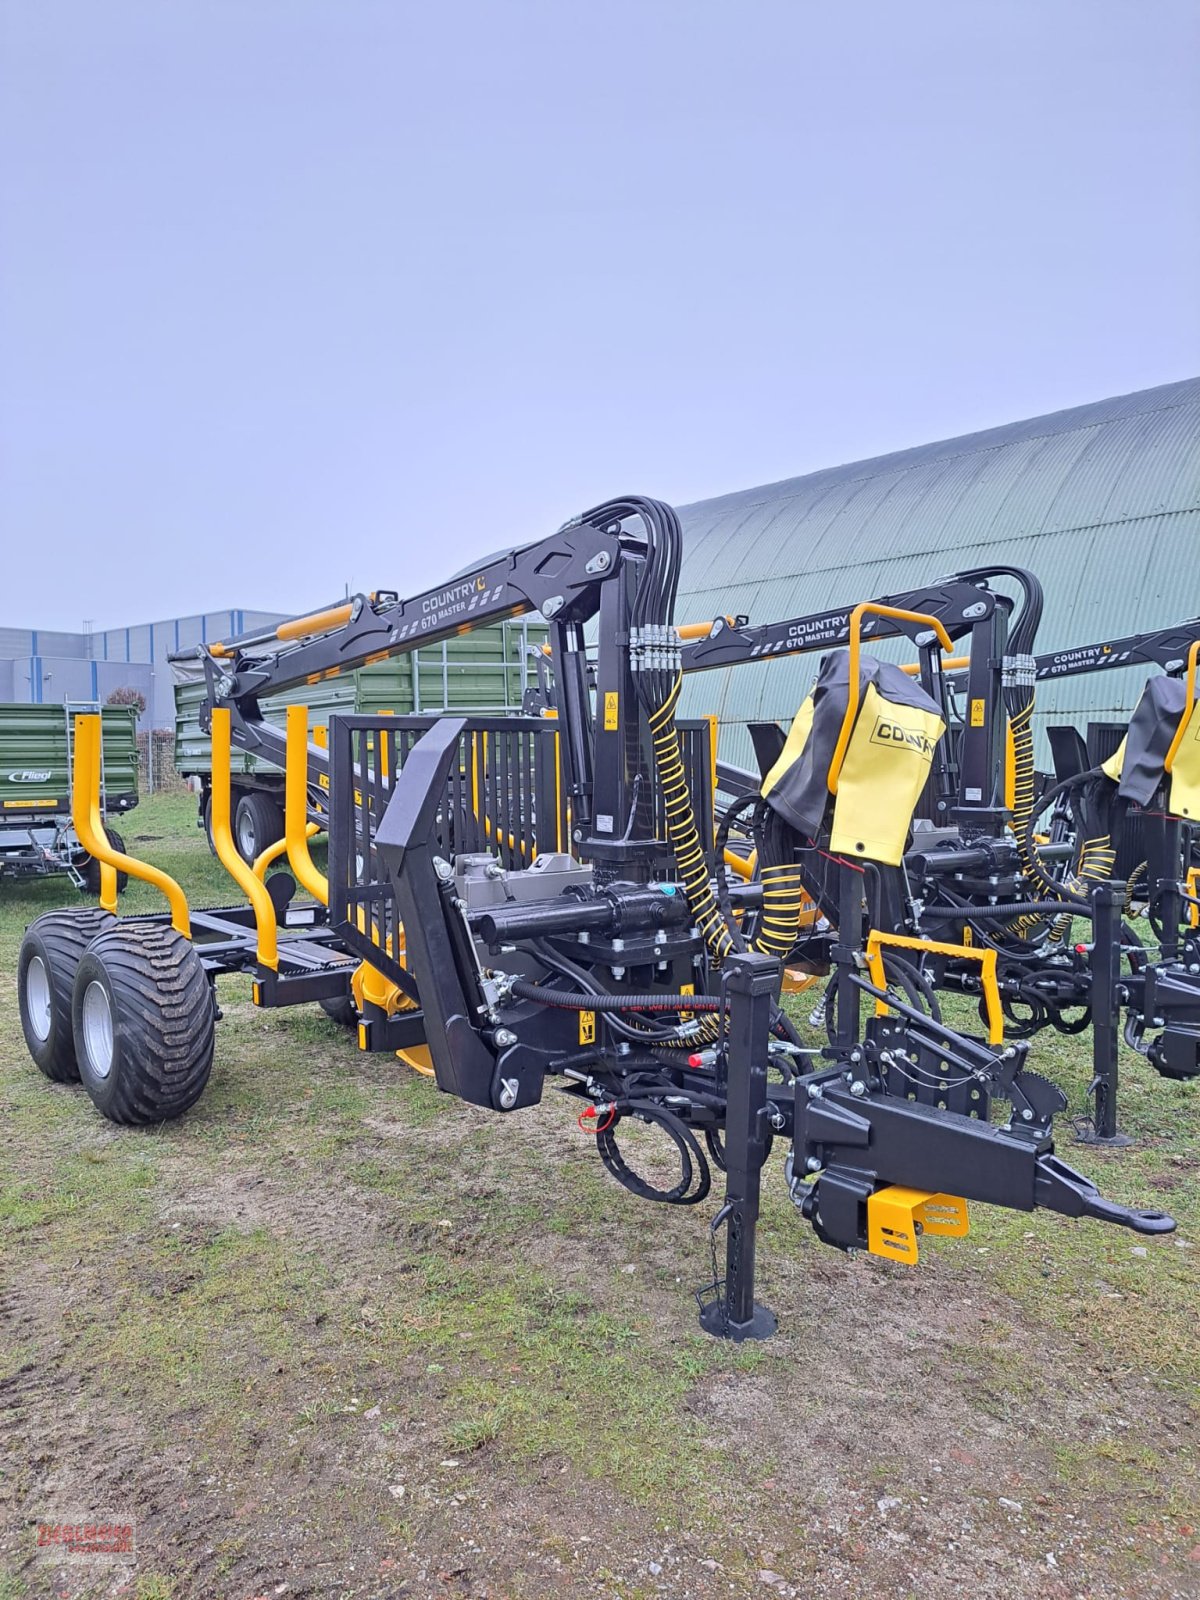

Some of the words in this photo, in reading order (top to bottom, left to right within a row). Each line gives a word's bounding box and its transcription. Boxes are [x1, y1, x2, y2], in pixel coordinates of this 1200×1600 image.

[422, 580, 476, 613] COUNTRY
[421, 614, 438, 630] 670
[438, 601, 466, 620] MASTER
[788, 614, 848, 637] COUNTRY
[786, 637, 804, 649] 670
[804, 629, 836, 643] MASTER
[1054, 647, 1101, 664] COUNTRY
[1051, 665, 1068, 674] 670
[1068, 659, 1095, 669] MASTER
[22, 770, 52, 780] Fliegl
